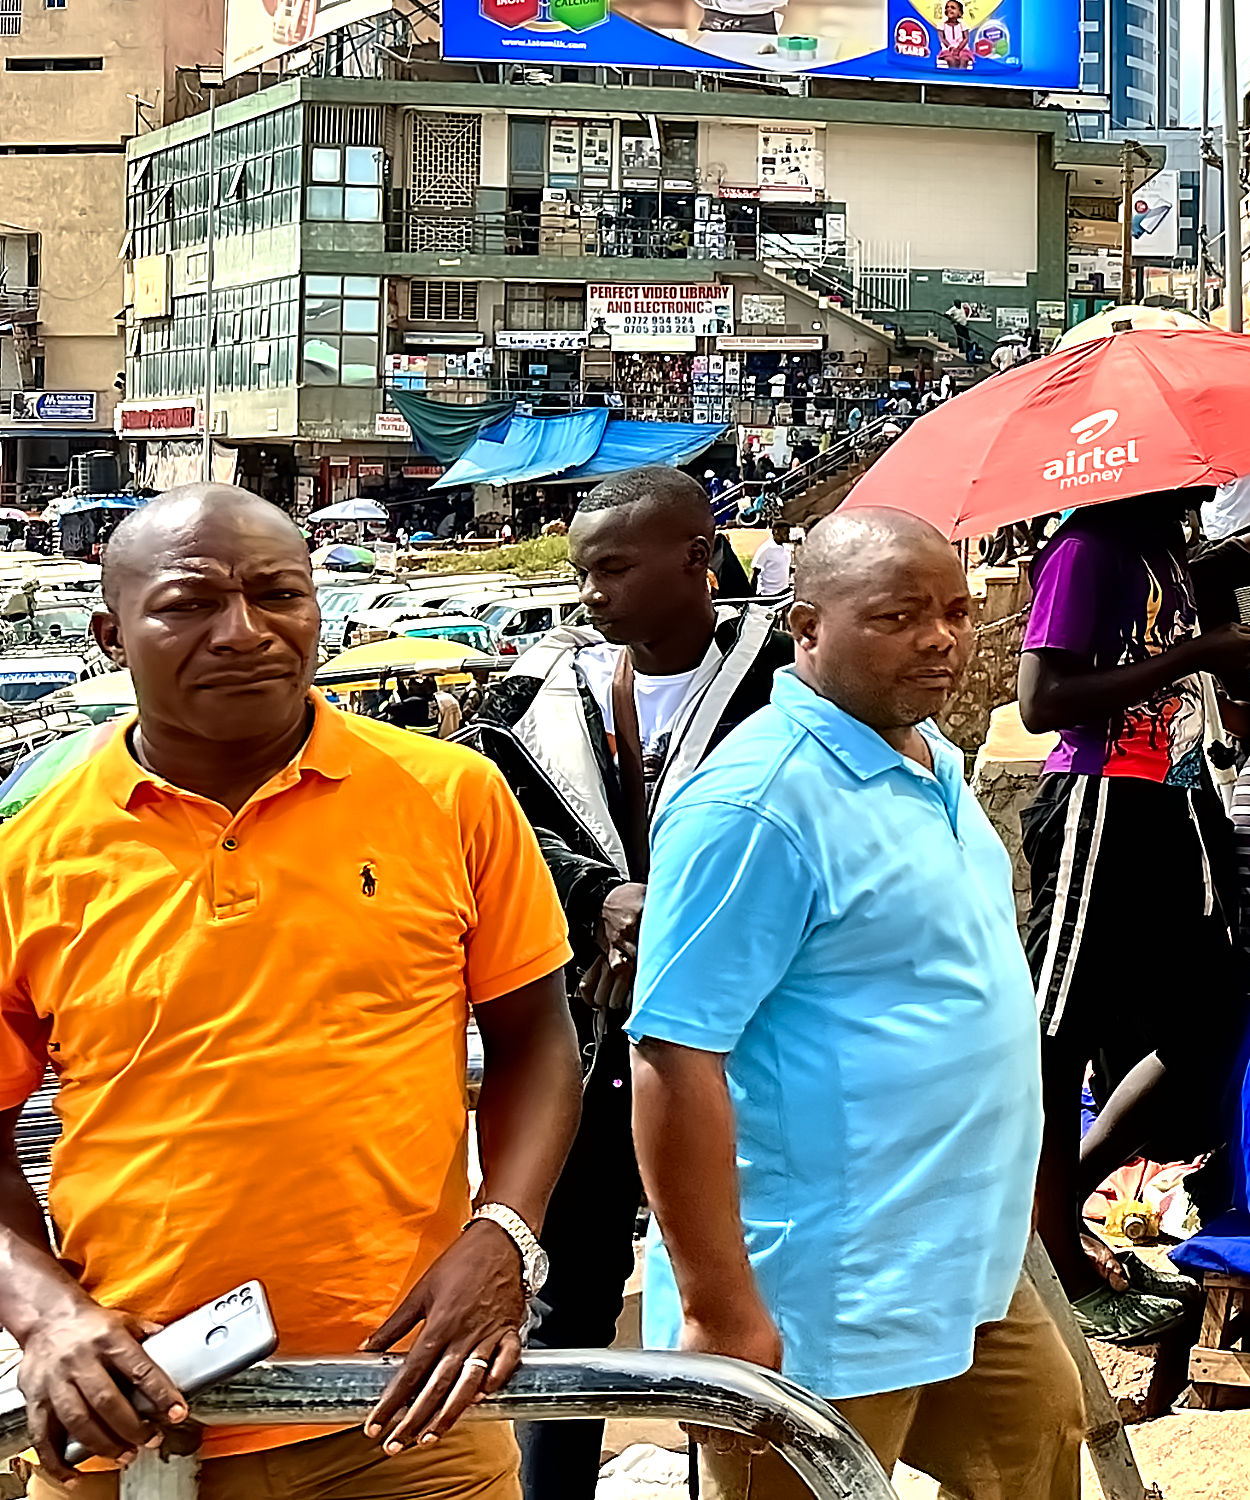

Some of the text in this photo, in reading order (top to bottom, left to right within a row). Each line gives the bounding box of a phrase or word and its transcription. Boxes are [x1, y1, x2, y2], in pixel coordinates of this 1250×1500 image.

[898, 28, 922, 44] 3-5
[590, 286, 730, 299] PERFECT VIDEO LIBRARY
[606, 301, 713, 314] AND ELECTRONICS
[1043, 439, 1140, 481] airtel
[1060, 467, 1124, 491] money
